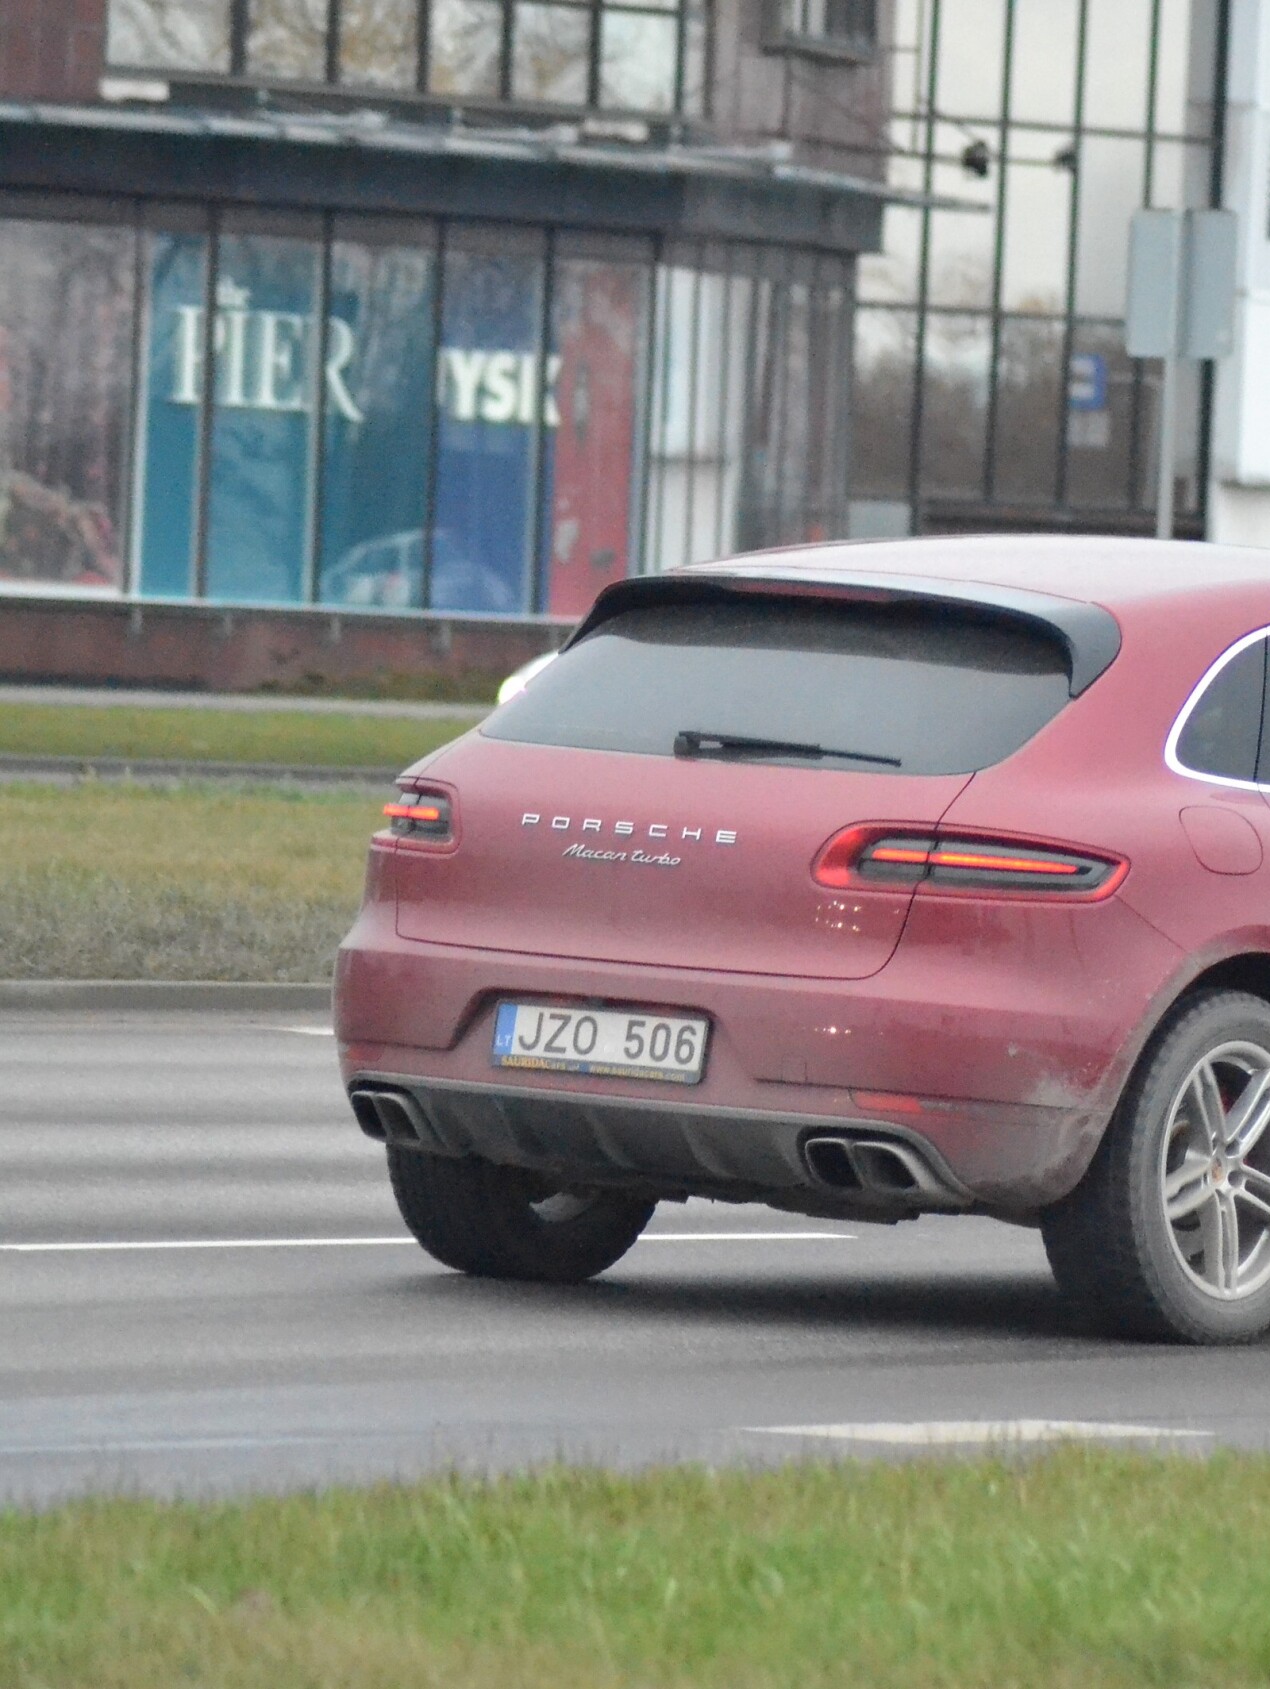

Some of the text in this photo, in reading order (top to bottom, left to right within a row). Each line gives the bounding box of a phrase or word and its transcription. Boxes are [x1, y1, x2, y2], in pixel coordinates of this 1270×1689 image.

[172, 304, 365, 424] PIER
[521, 812, 738, 844] PORSCHE
[562, 842, 682, 867] Macan turbo
[495, 1034, 512, 1048] LT
[518, 1011, 698, 1066] JZO 506
